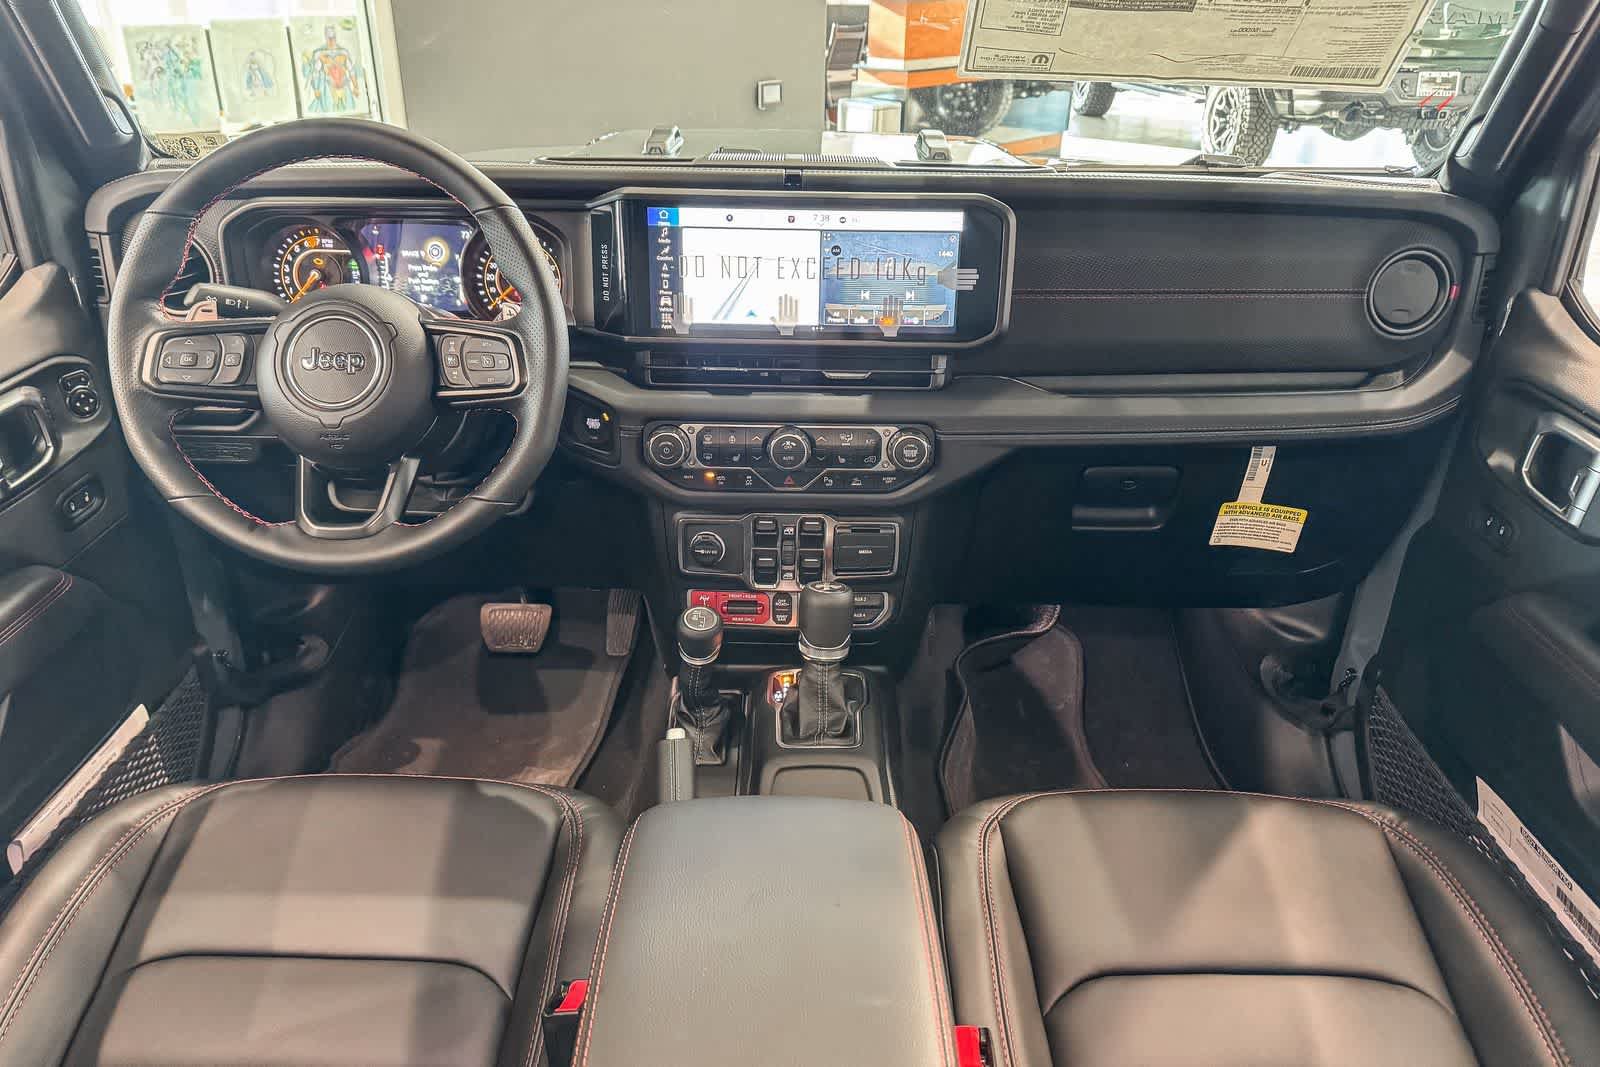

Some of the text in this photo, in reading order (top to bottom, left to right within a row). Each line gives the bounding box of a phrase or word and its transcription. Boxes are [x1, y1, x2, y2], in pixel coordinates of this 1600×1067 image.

[601, 244, 609, 270] PRESS
[680, 255, 926, 287] DO NOT EXCEED 10Kg
[602, 290, 610, 301] DO
[302, 347, 366, 374] Jeep
[1270, 508, 1302, 517] EQUIPPED
